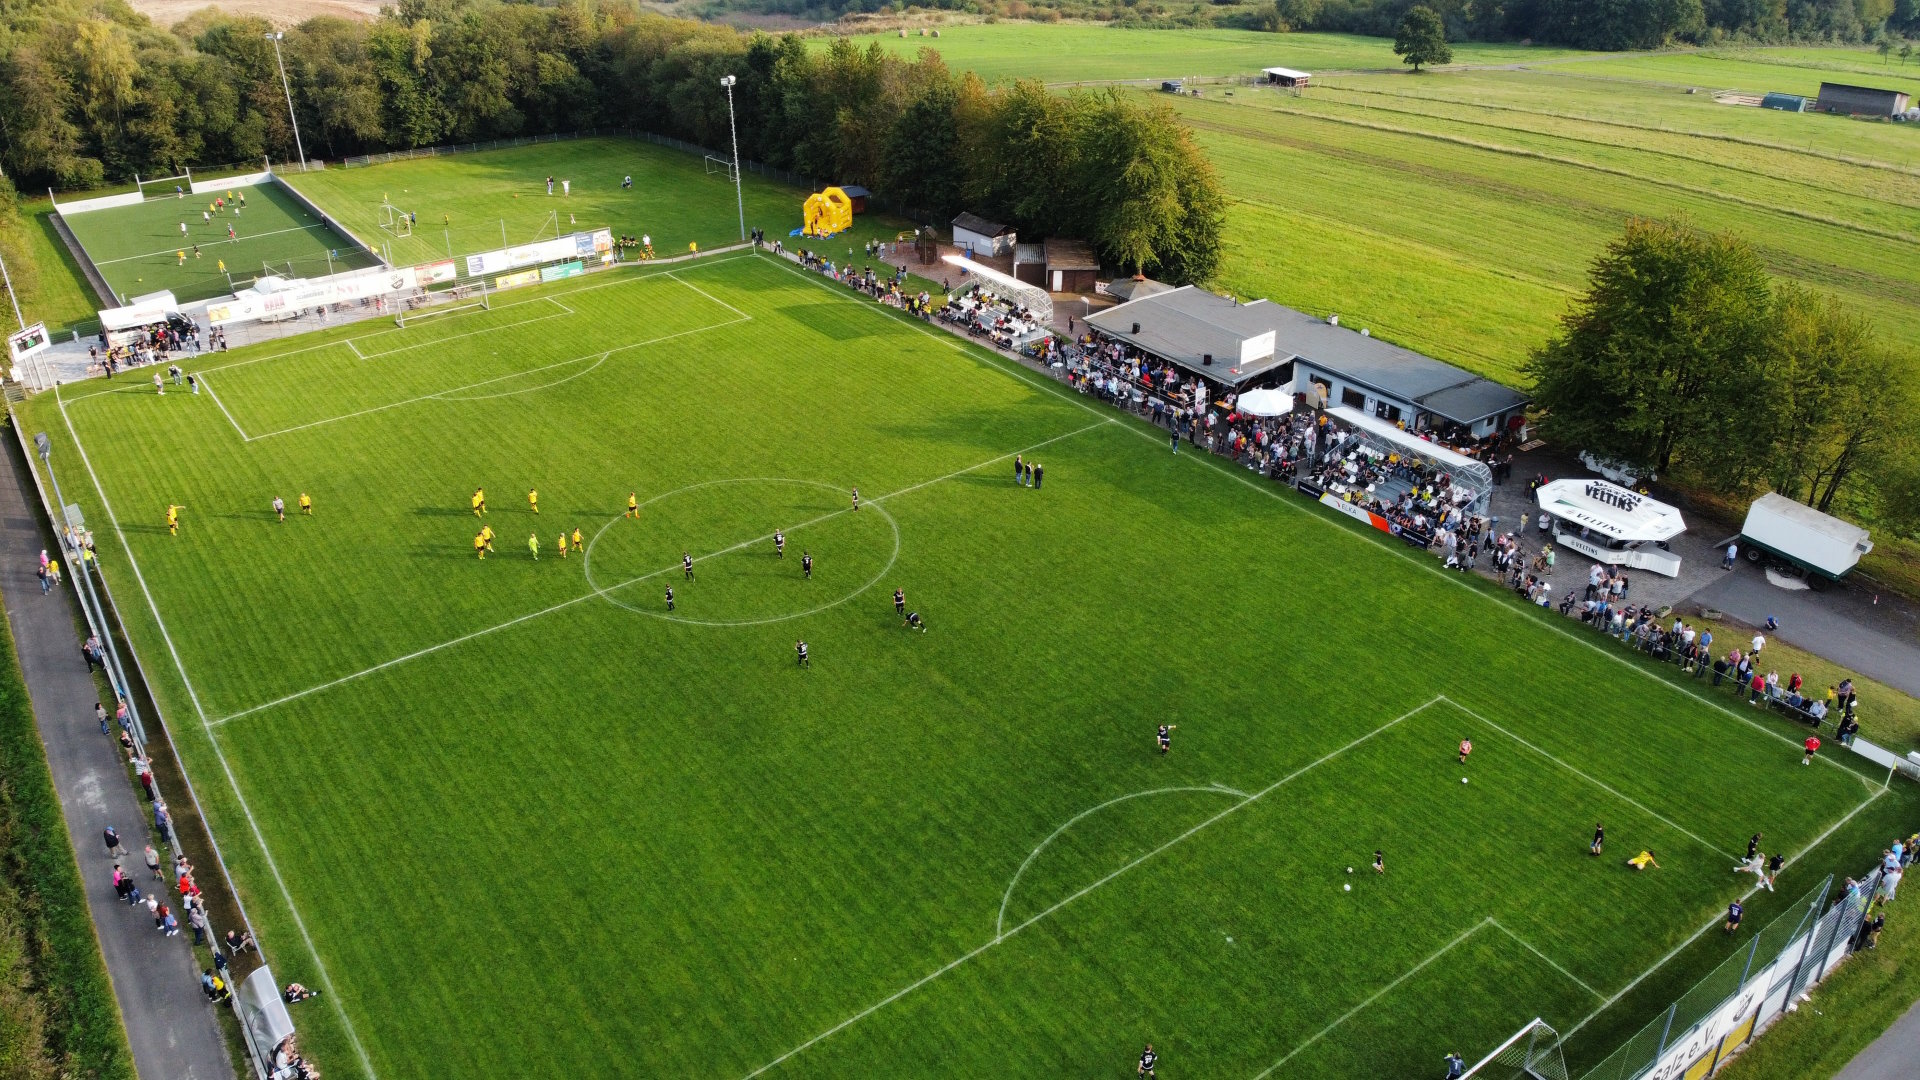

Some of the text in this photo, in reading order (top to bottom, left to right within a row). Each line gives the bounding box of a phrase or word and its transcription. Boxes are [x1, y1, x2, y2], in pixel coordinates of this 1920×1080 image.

[1341, 503, 1357, 515] ELKA
[1585, 484, 1633, 512] VELTINS
[1576, 513, 1625, 535] VELTINS
[1575, 541, 1598, 556] VELTINS
[1688, 1041, 1701, 1059] e.
[1704, 1021, 1717, 1045] V.
